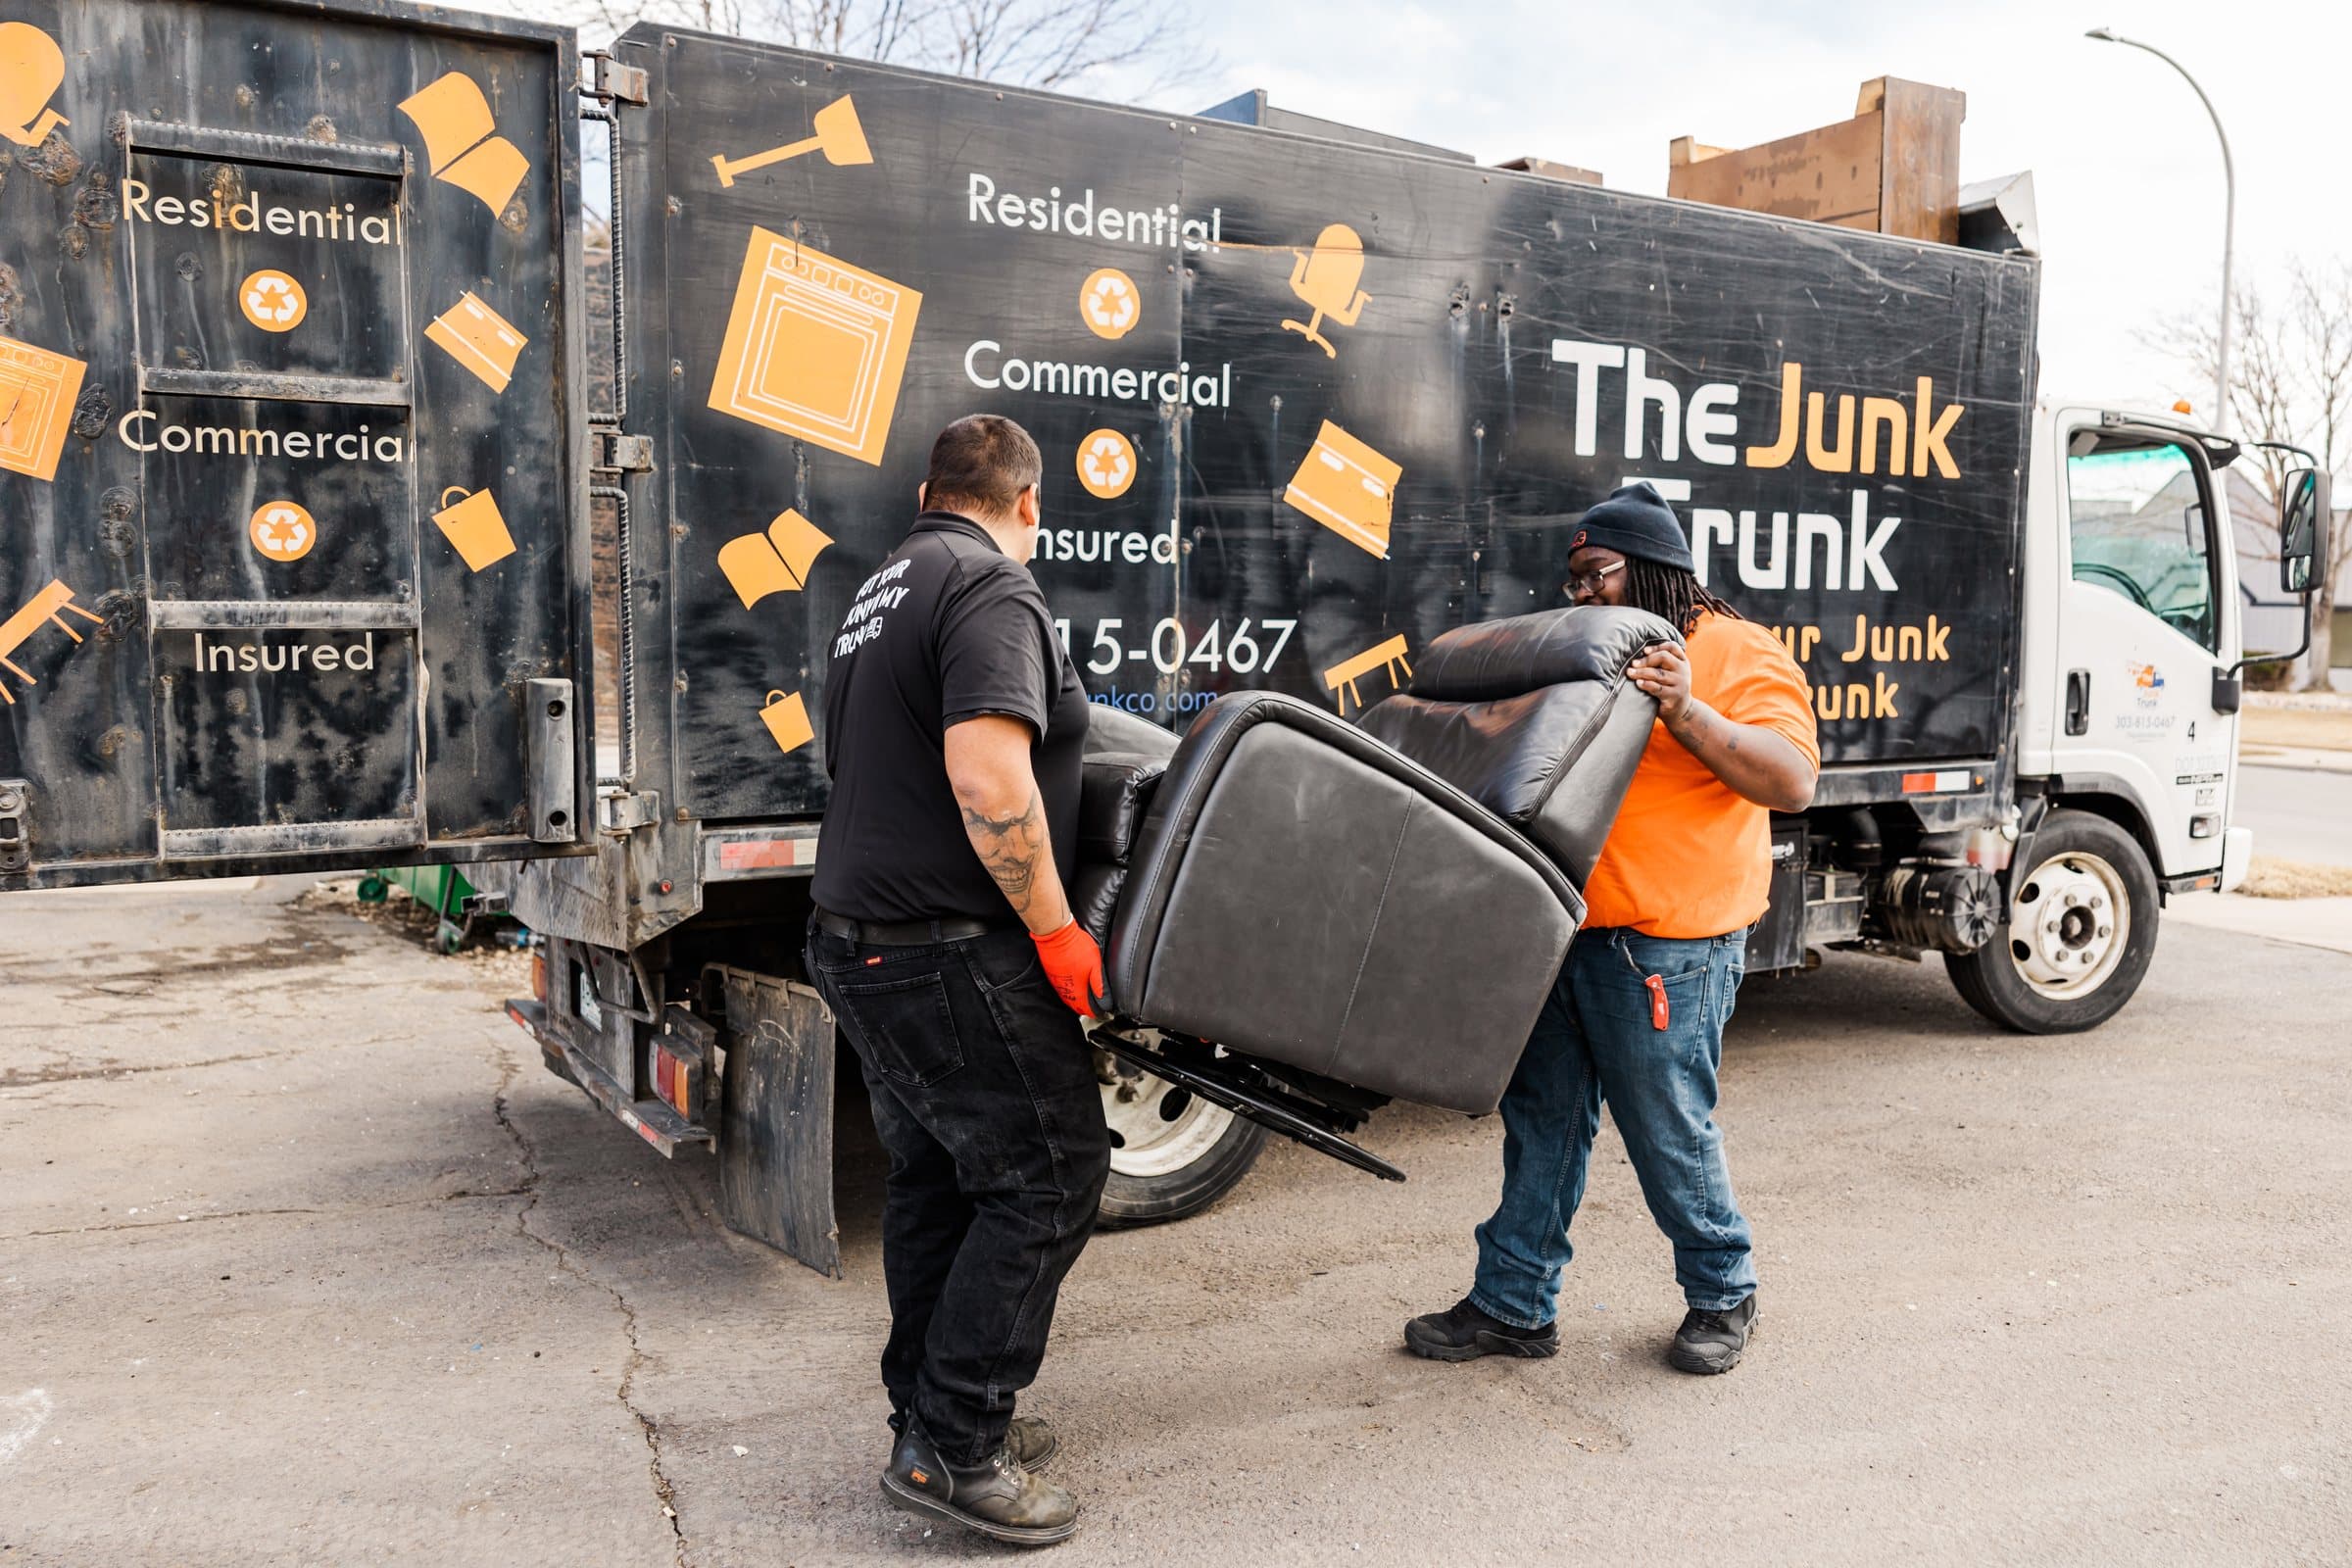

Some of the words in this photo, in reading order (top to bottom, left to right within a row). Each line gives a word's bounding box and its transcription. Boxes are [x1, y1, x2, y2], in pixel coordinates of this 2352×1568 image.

[122, 178, 403, 245] Residential
[968, 172, 1221, 253] Residential
[964, 340, 1231, 407] Commercial
[1551, 338, 1740, 466] The
[1745, 362, 1966, 479] Junk
[118, 410, 416, 463] Commercia
[1030, 518, 1178, 564] nsured
[195, 631, 374, 672] Insured
[1054, 616, 1298, 675] 15-0467
[1840, 613, 1951, 663] Junk
[1806, 671, 1899, 721] unk
[2187, 720, 2196, 744] 4
